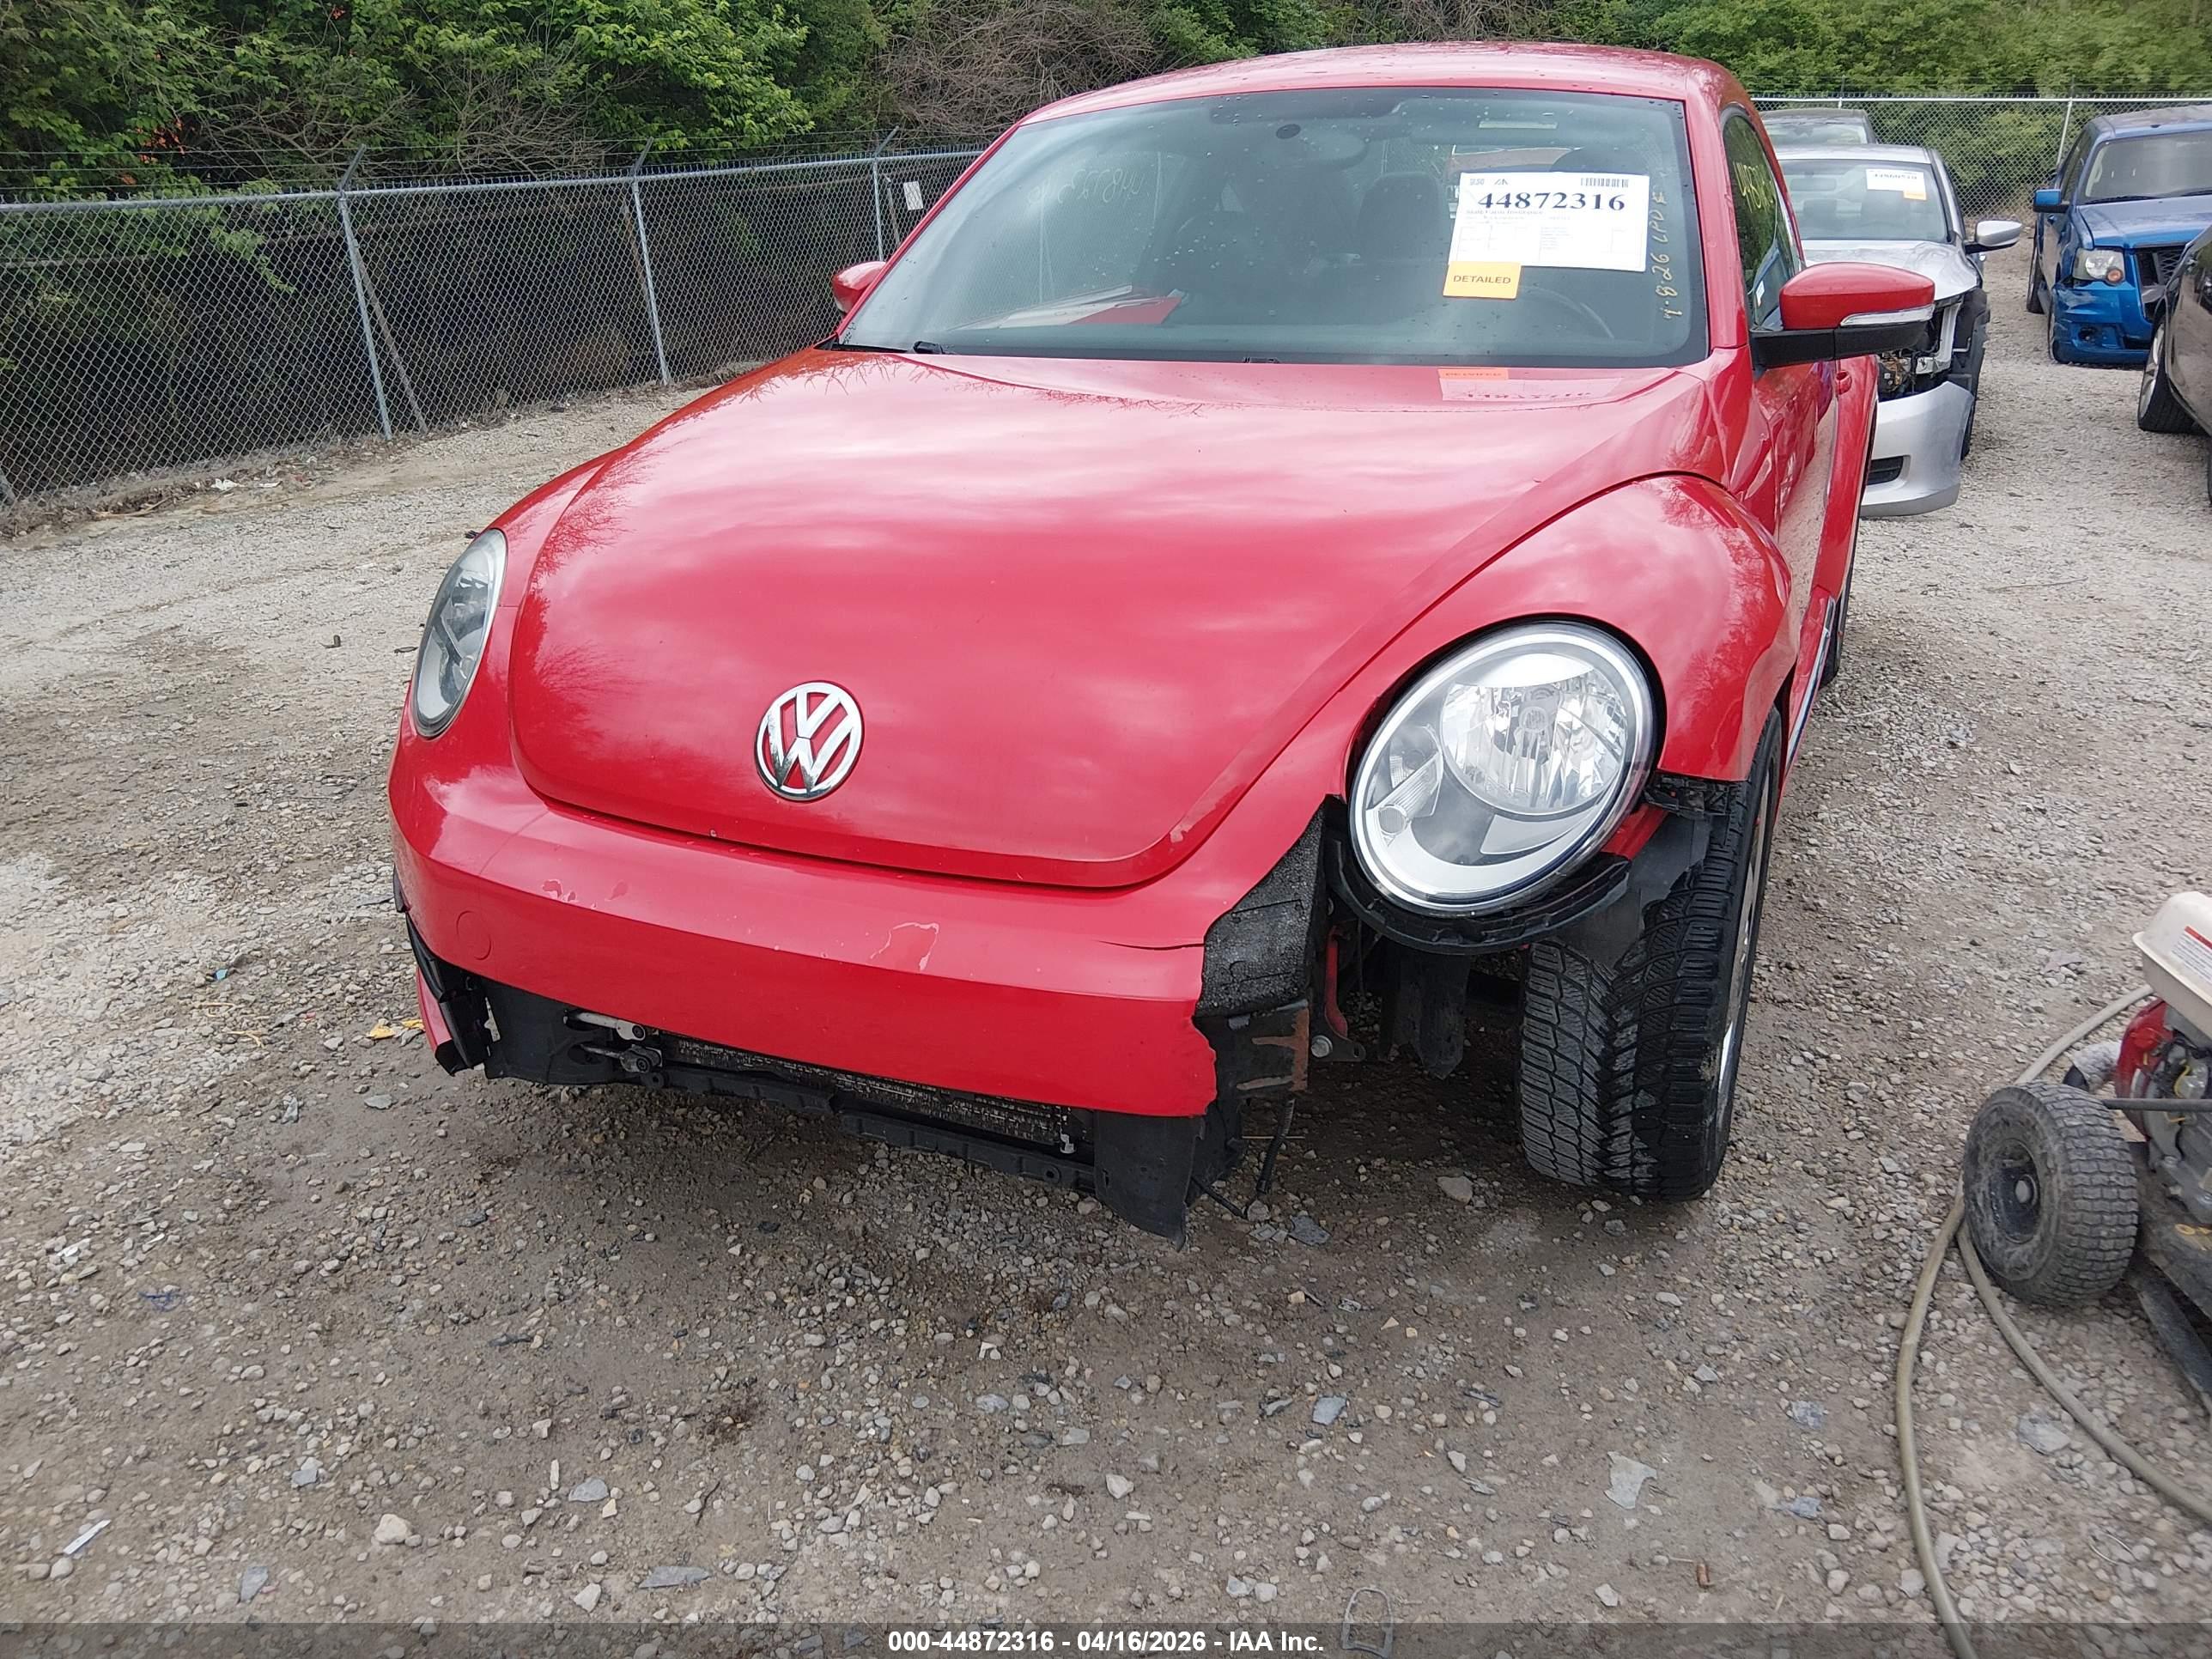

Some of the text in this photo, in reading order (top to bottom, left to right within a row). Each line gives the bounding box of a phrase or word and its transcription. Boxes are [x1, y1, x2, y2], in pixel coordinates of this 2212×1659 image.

[1477, 191, 1626, 211] 44872316
[1453, 275, 1511, 284] DETAILED
[761, 685, 860, 797] VW
